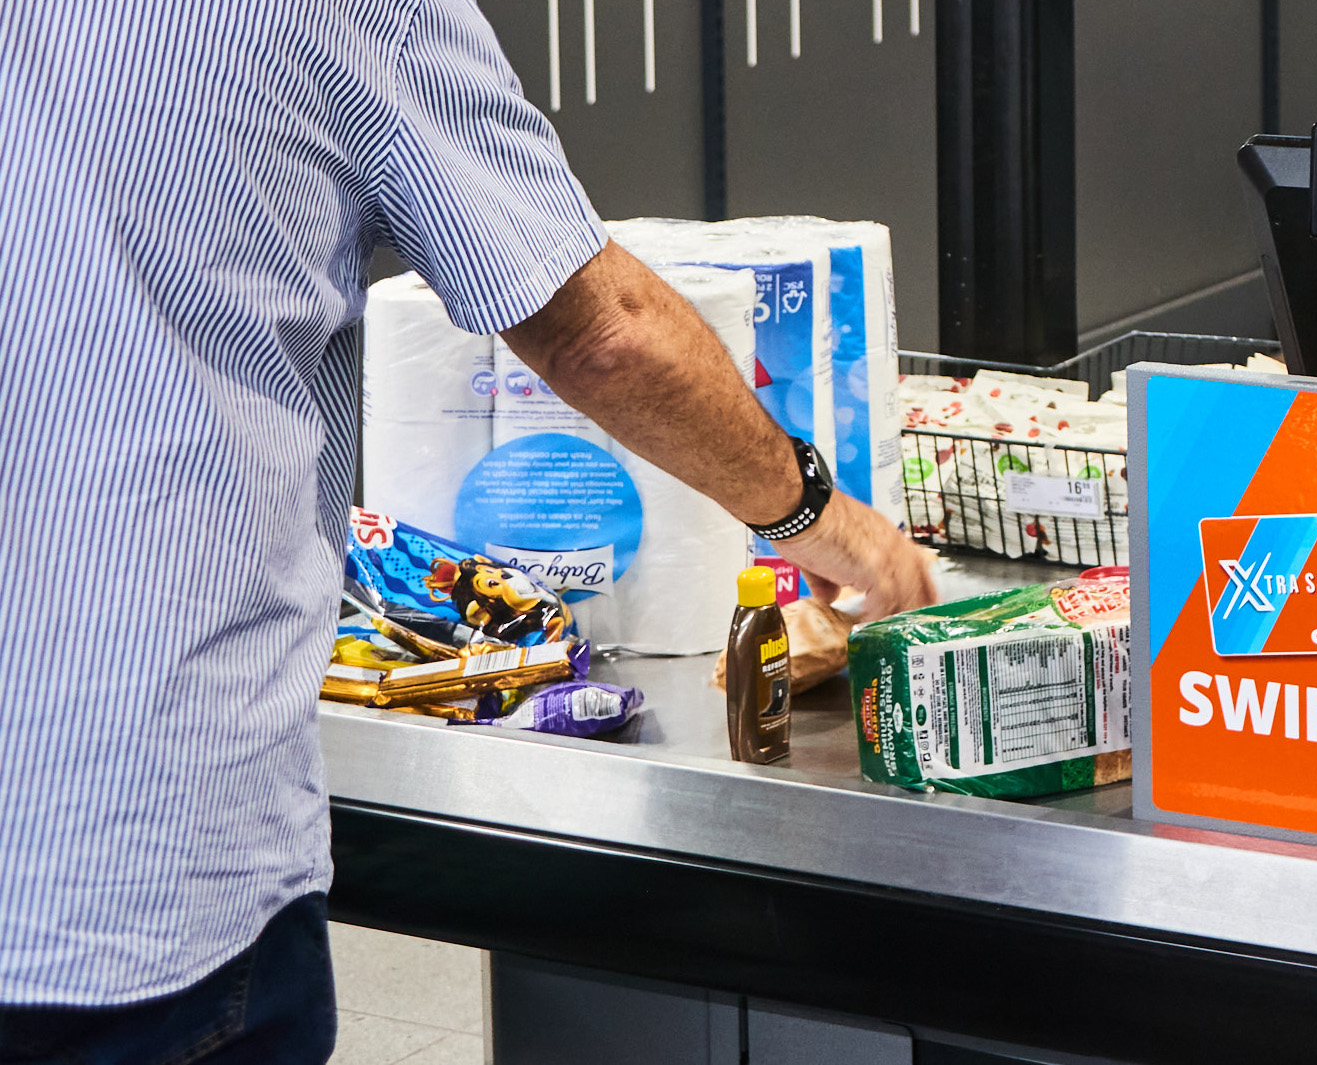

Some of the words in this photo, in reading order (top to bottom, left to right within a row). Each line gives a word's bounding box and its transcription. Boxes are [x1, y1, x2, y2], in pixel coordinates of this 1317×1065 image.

[783, 280, 804, 291] FSC
[541, 554, 606, 587] Baby
[1219, 552, 1299, 620] XTRA
[760, 633, 788, 664] plush
[879, 657, 887, 707] SLICES
[879, 711, 895, 777] PREMIUM
[886, 718, 897, 770] BROWN
